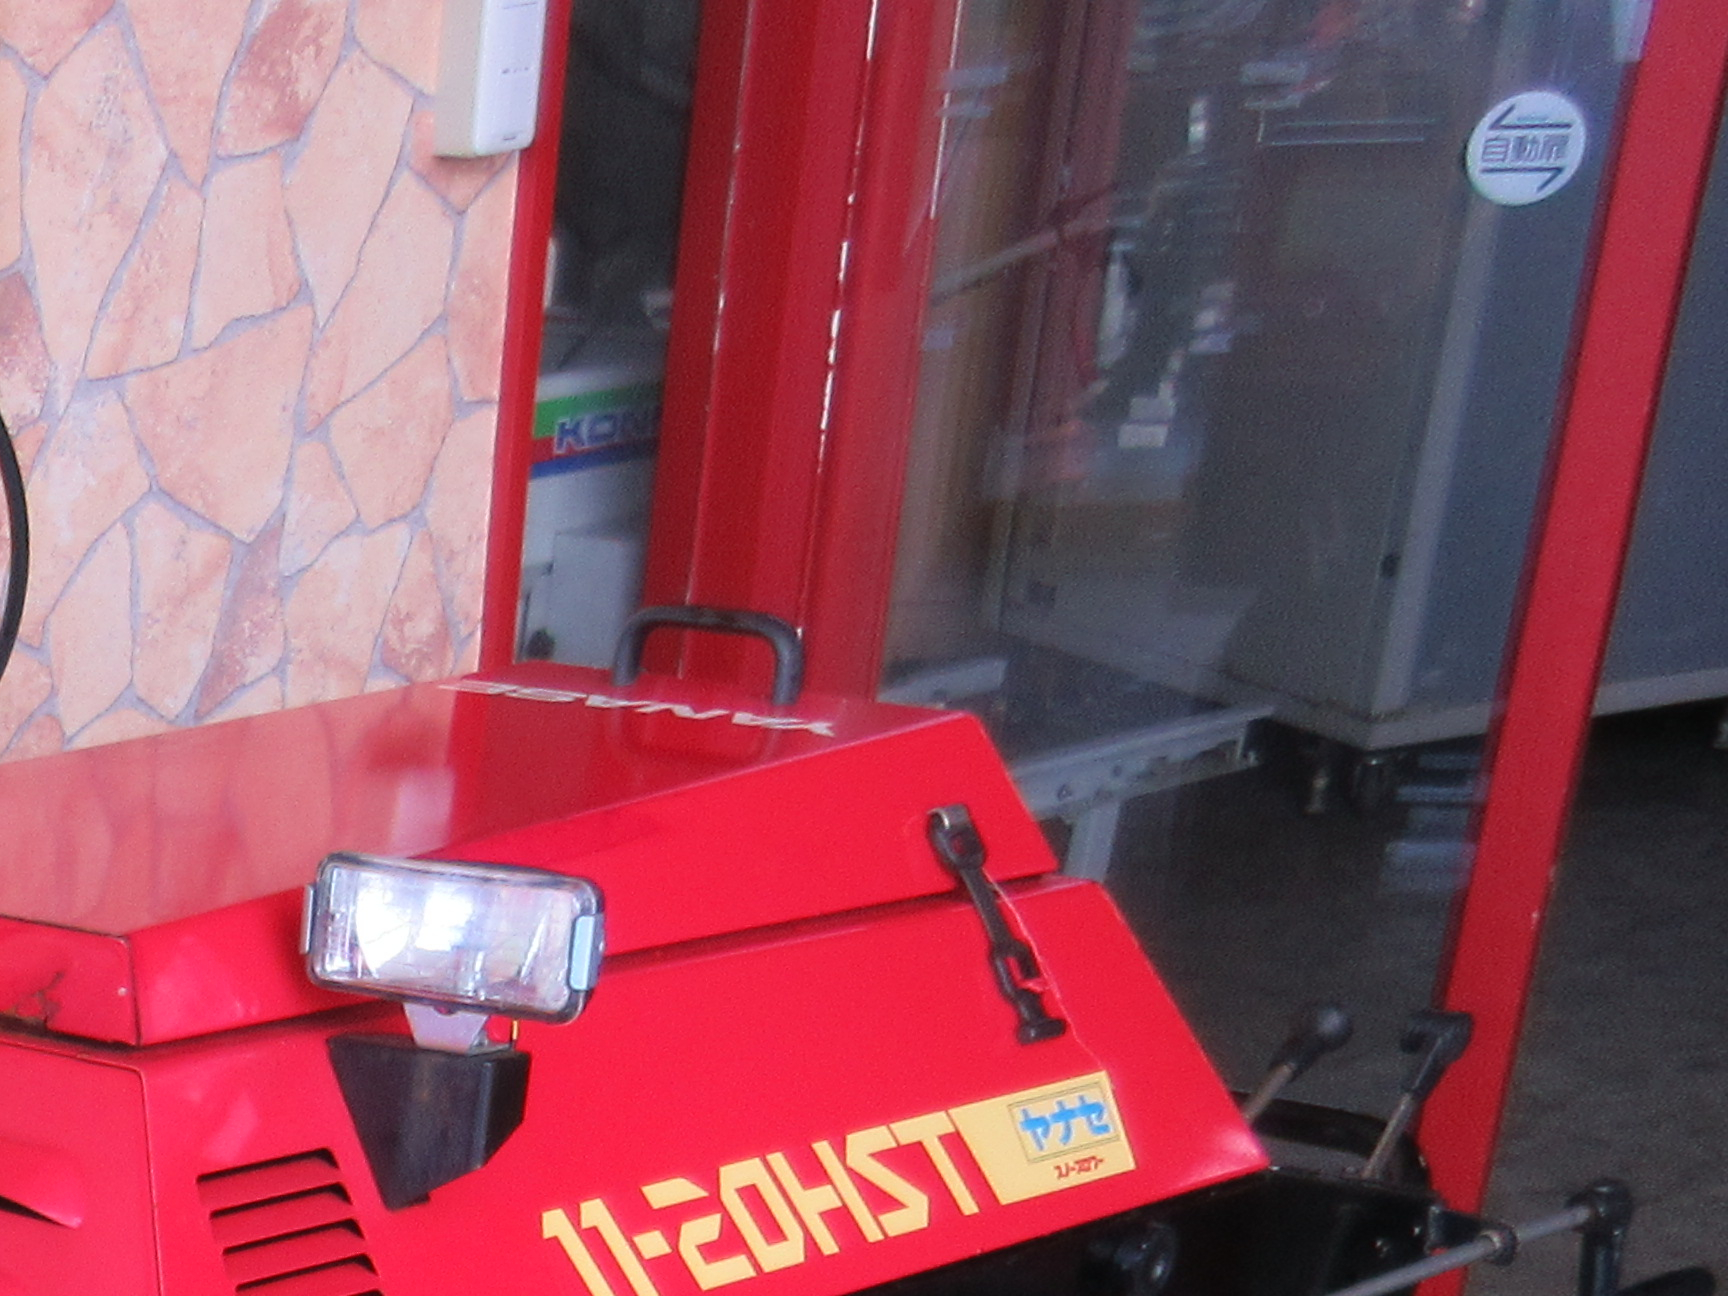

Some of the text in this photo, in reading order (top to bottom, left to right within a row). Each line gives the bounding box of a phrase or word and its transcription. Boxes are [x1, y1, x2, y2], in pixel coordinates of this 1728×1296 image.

[437, 678, 835, 738] YANASE
[1019, 1094, 1112, 1152] ヤナセ
